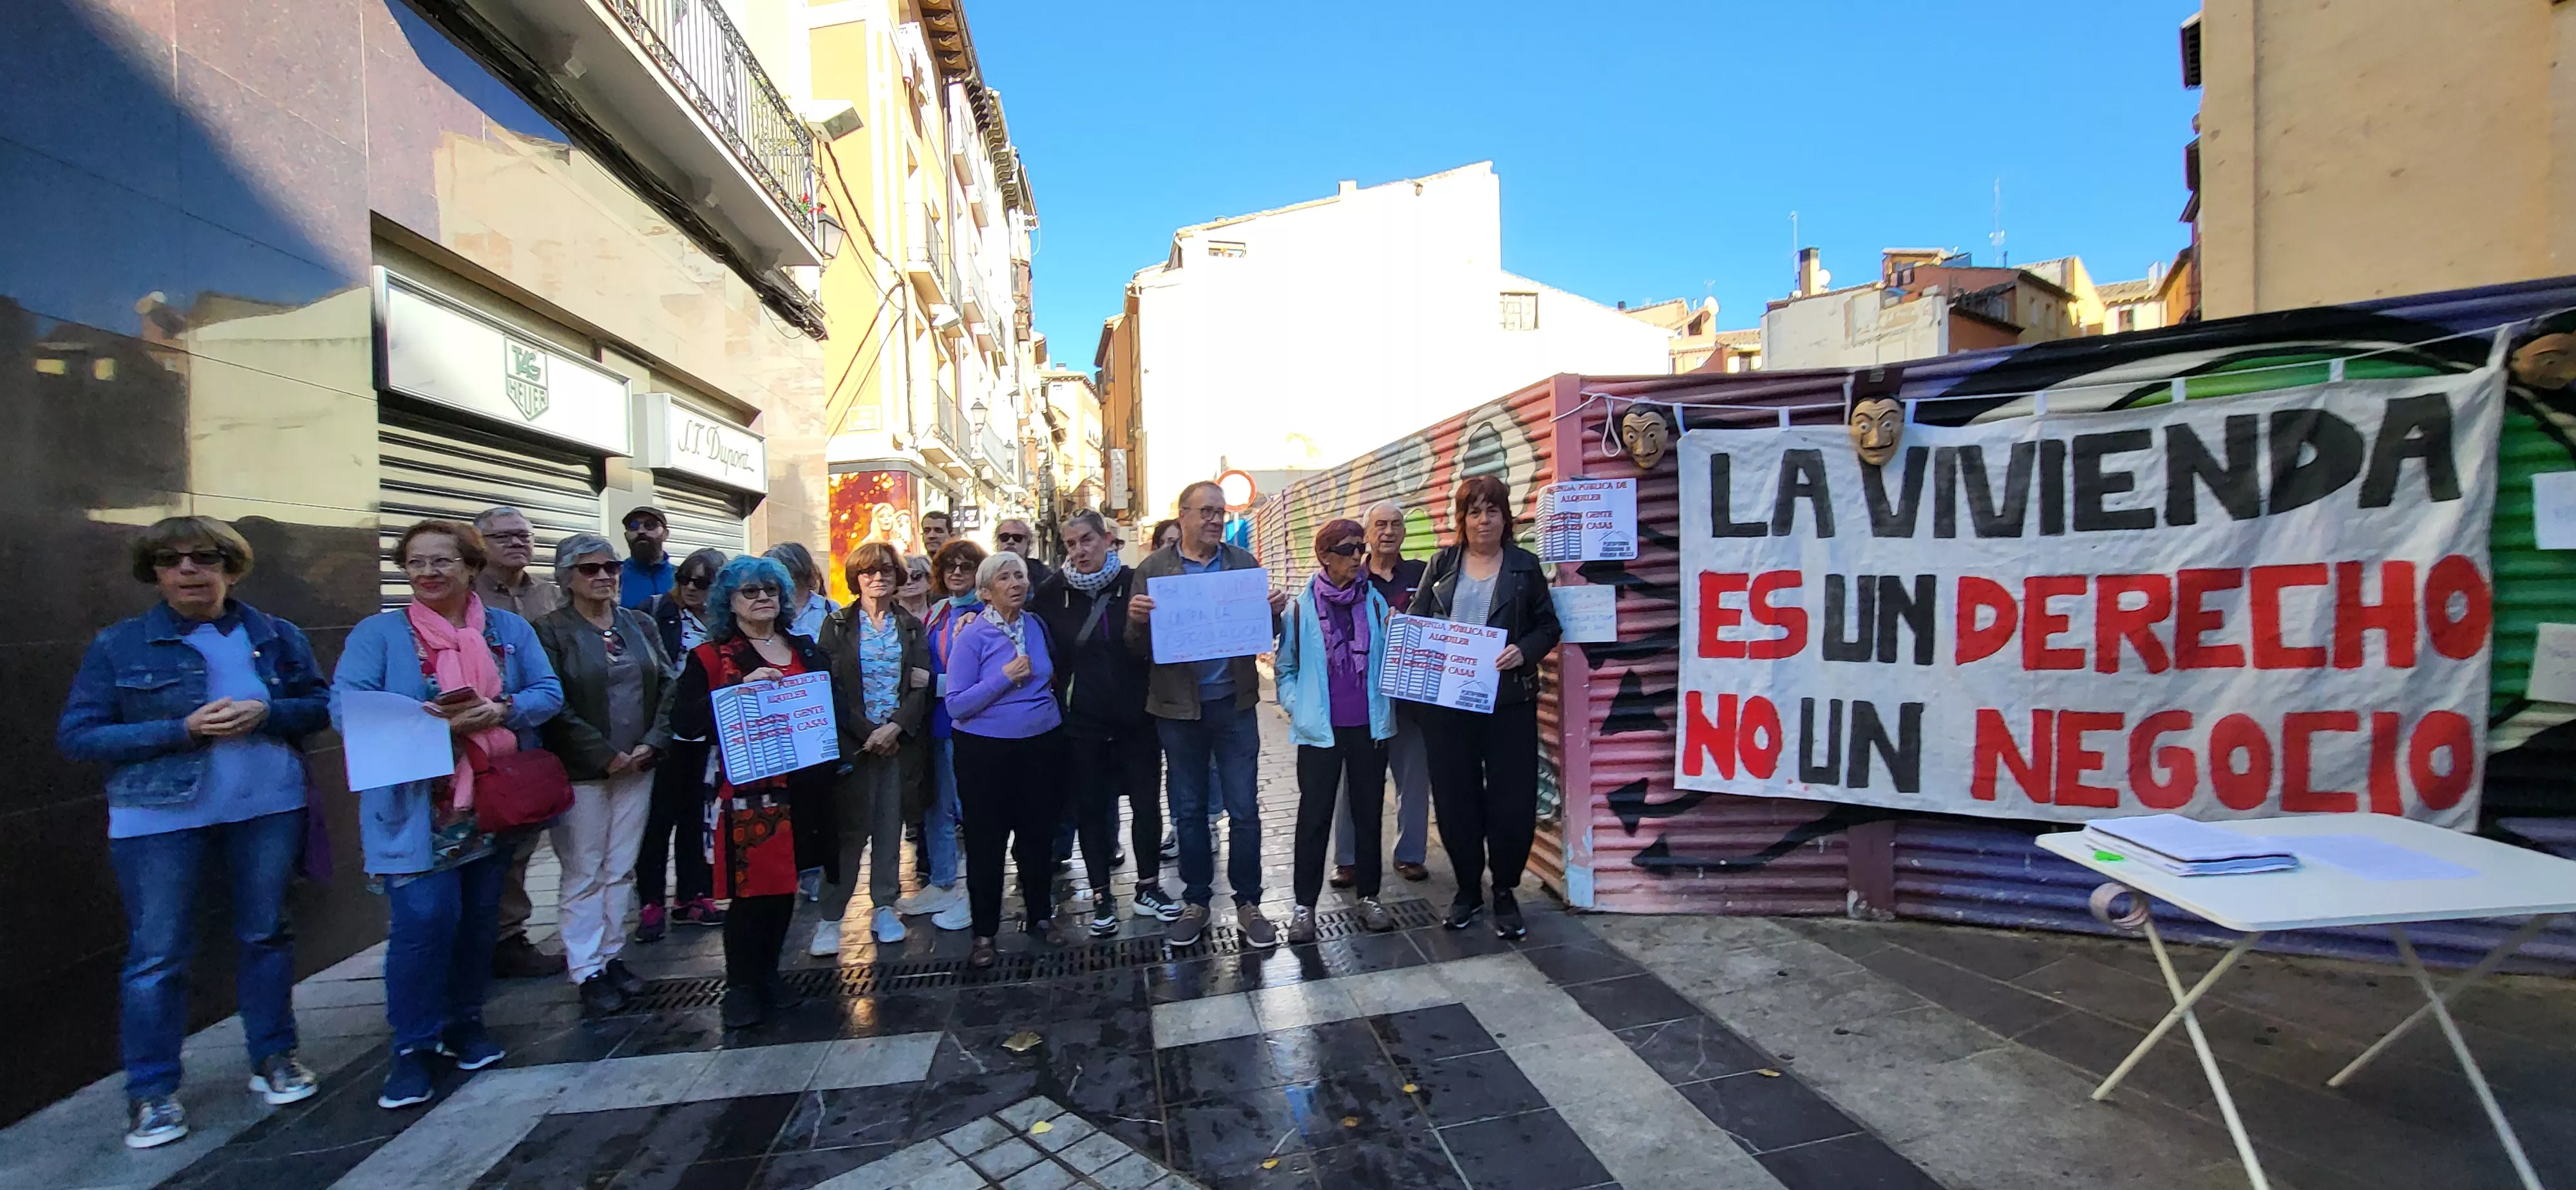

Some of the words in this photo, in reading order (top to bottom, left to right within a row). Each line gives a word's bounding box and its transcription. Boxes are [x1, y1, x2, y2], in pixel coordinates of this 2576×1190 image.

[511, 345, 541, 382] TAG
[507, 379, 547, 416] HEUER
[706, 426, 754, 476] Dupont
[1709, 449, 1835, 538] LA
[1858, 393, 2462, 539] VIVIENDA
[1586, 522, 1613, 530] CASAS
[1699, 571, 1808, 659] ES
[1823, 574, 1936, 666] UN
[1956, 555, 2492, 674] DERECHO
[1486, 630, 1499, 639] DE
[1448, 666, 1475, 678] CASAS
[797, 718, 828, 732] CASAS
[1683, 691, 1782, 780] NO
[1799, 697, 1924, 793] UN
[1972, 709, 2472, 817] NEGOCIO
